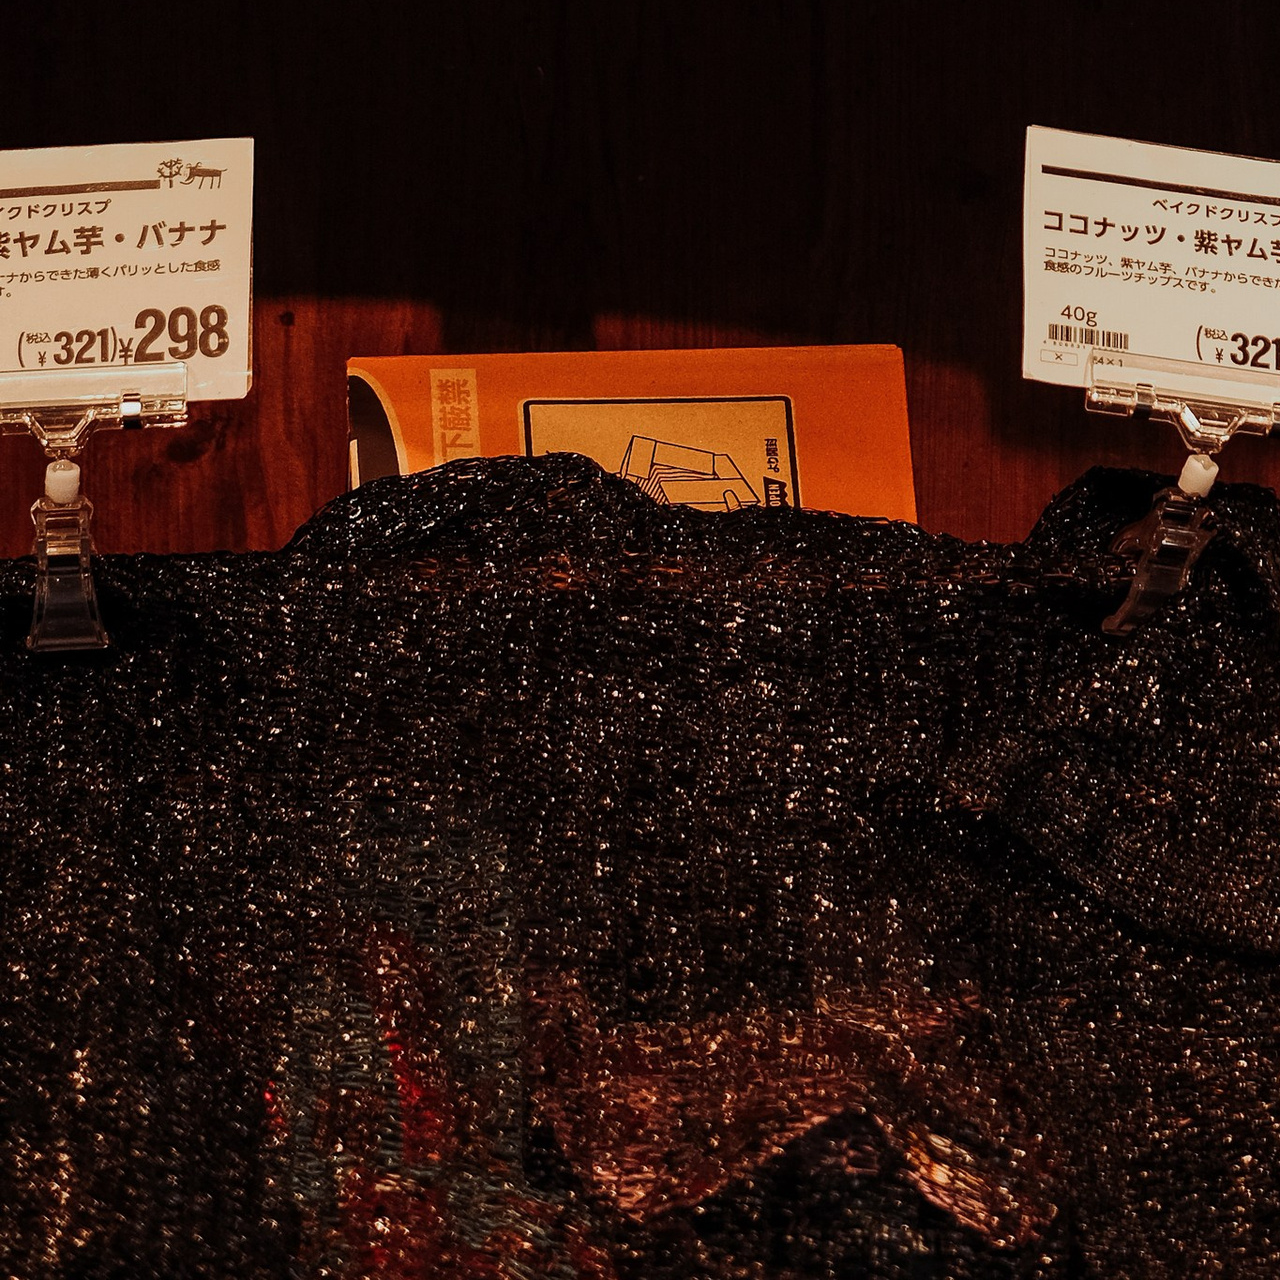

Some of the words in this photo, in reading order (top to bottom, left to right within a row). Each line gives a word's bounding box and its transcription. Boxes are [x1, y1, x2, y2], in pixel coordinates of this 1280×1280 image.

[0, 199, 112, 220] クドクリスプ
[1043, 260, 1217, 294] 食感のフルーツチップスです。
[1061, 304, 1098, 326] 40g
[768, 484, 781, 507] OPEN
